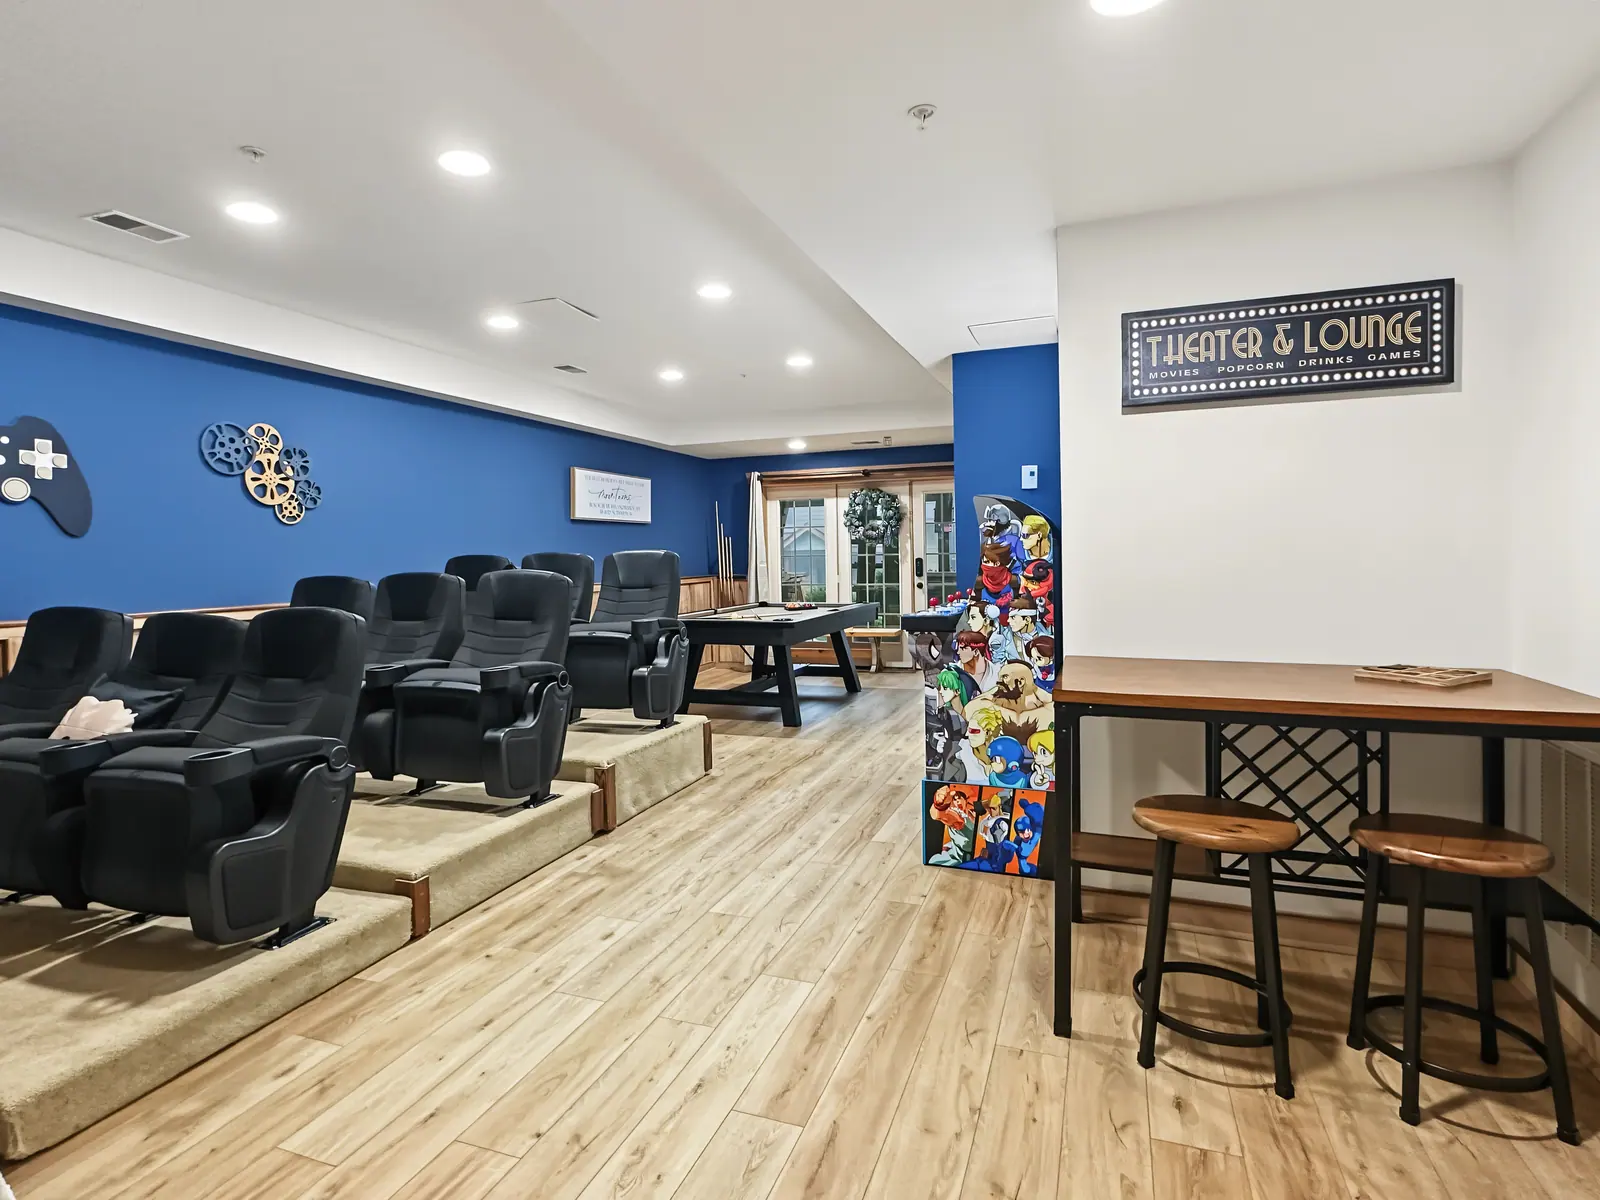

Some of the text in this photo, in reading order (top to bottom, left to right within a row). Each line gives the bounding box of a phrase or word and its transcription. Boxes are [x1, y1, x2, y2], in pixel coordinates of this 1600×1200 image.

[1146, 310, 1422, 367] THEATER & LOUNGE
[1149, 368, 1200, 379] MOVIES
[1217, 361, 1285, 373] POPCORN
[1298, 355, 1354, 367] DRINKS
